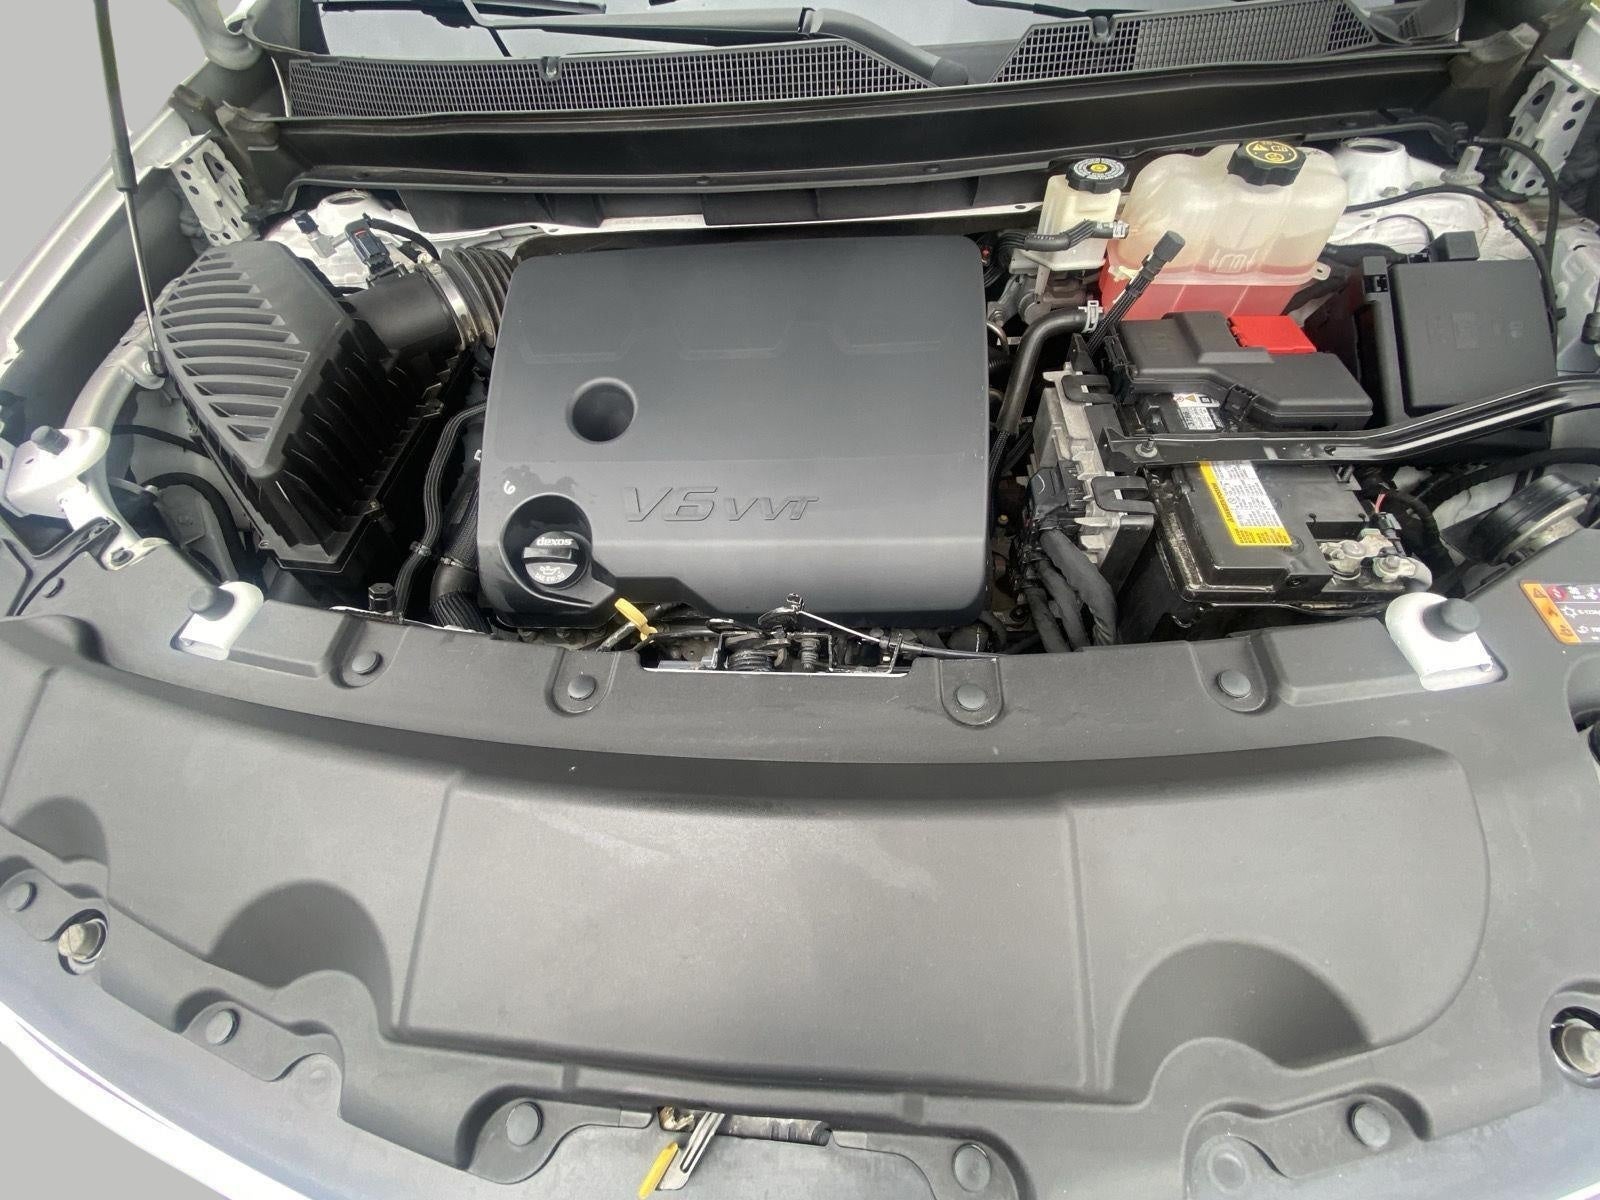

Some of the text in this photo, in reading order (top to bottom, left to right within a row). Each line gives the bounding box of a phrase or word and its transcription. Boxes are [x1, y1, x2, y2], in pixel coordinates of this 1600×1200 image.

[622, 486, 820, 522] V6 VVT
[536, 536, 575, 546] dexos
